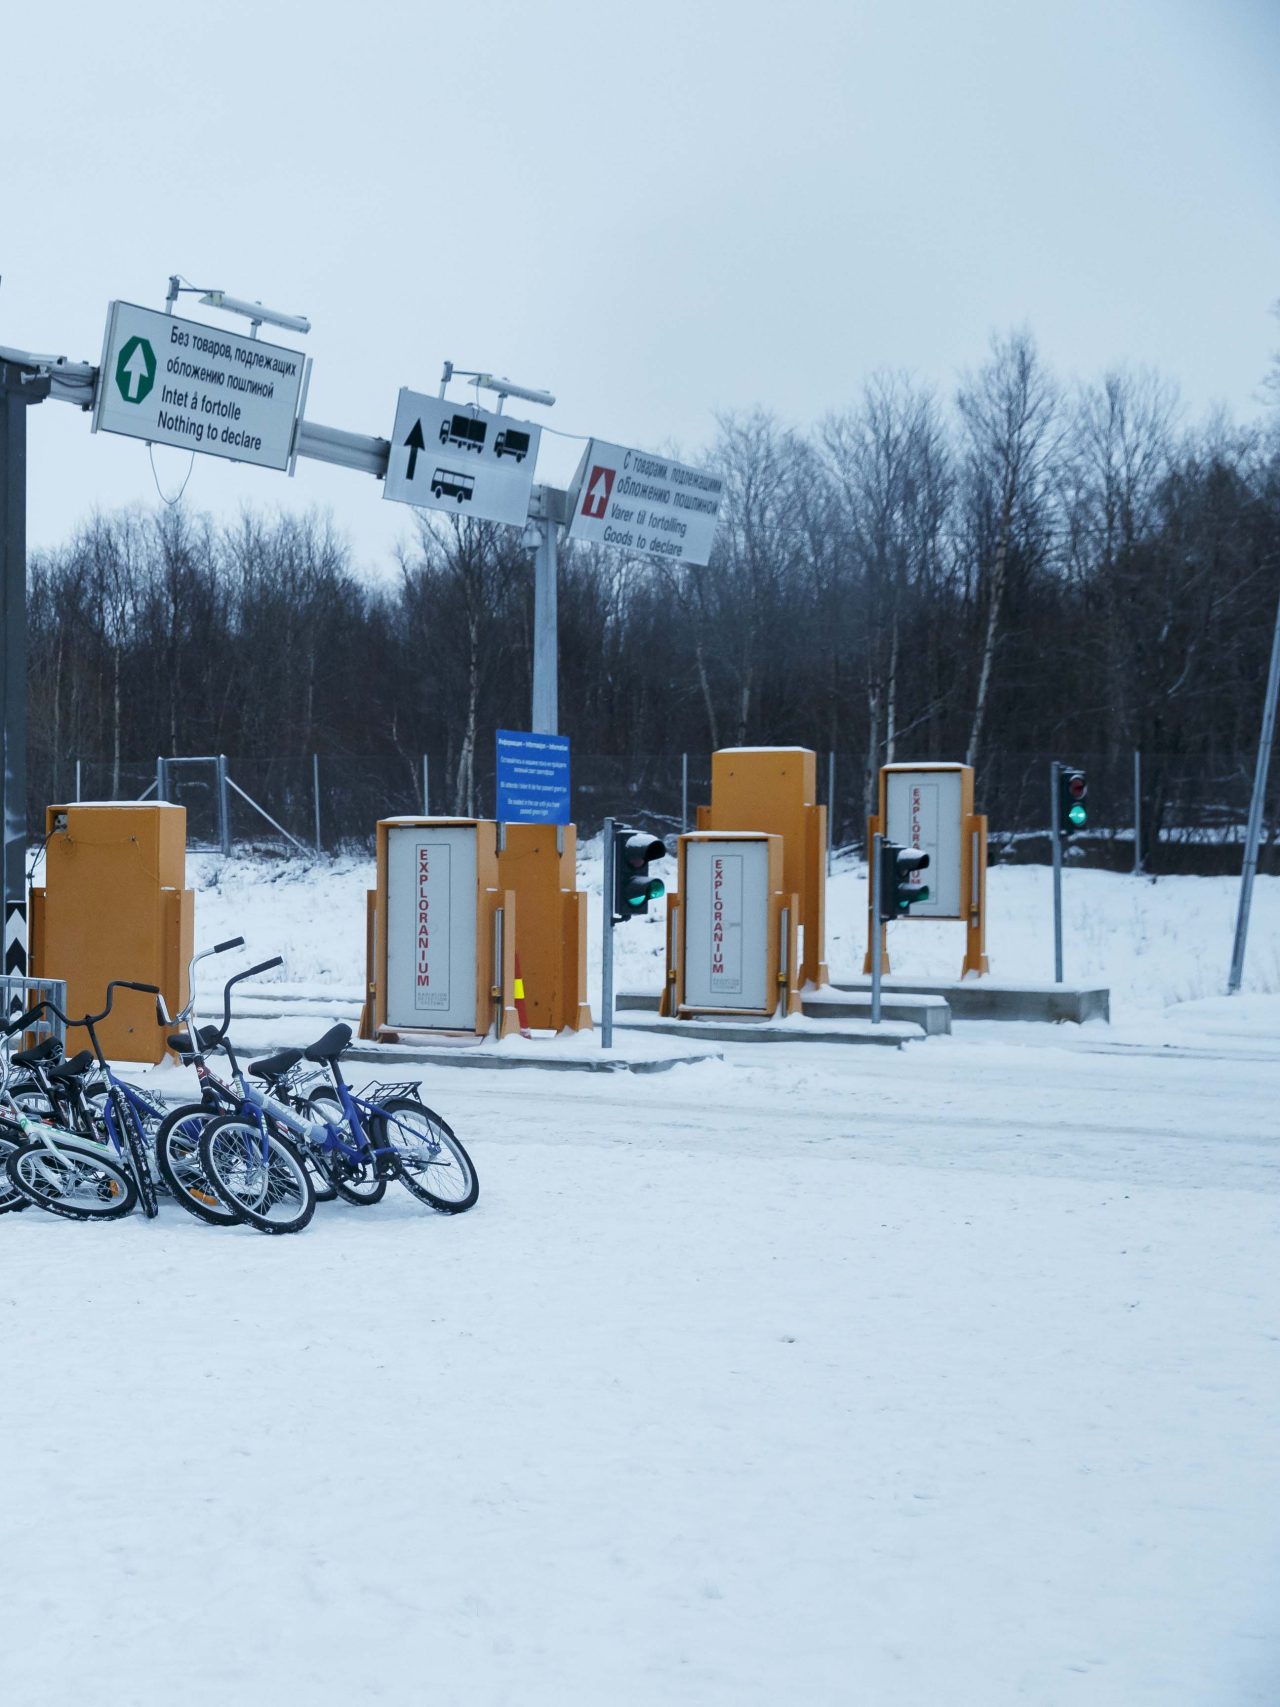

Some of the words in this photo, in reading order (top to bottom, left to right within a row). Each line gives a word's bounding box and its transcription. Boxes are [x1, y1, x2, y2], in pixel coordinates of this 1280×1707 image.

[170, 325, 190, 347] Без
[192, 335, 232, 360] товаров,
[234, 347, 297, 378] подлежащих
[166, 356, 225, 385] обложению
[226, 374, 274, 398] пошлиной
[161, 385, 189, 408] Intet
[190, 391, 198, 410] å
[201, 395, 241, 420] fortolle
[157, 410, 204, 442] Nothing
[207, 423, 218, 440] to
[221, 426, 262, 450] declare
[623, 450, 631, 470] С
[616, 476, 670, 504] обложению
[610, 502, 634, 522] Varer
[636, 509, 647, 525] til
[648, 512, 687, 538] fortolling
[603, 525, 633, 547] Goods
[636, 534, 646, 549] to
[649, 536, 683, 557] declare
[417, 849, 430, 987] EXPLORANIUM
[712, 859, 723, 974] EXPLORANIUM
